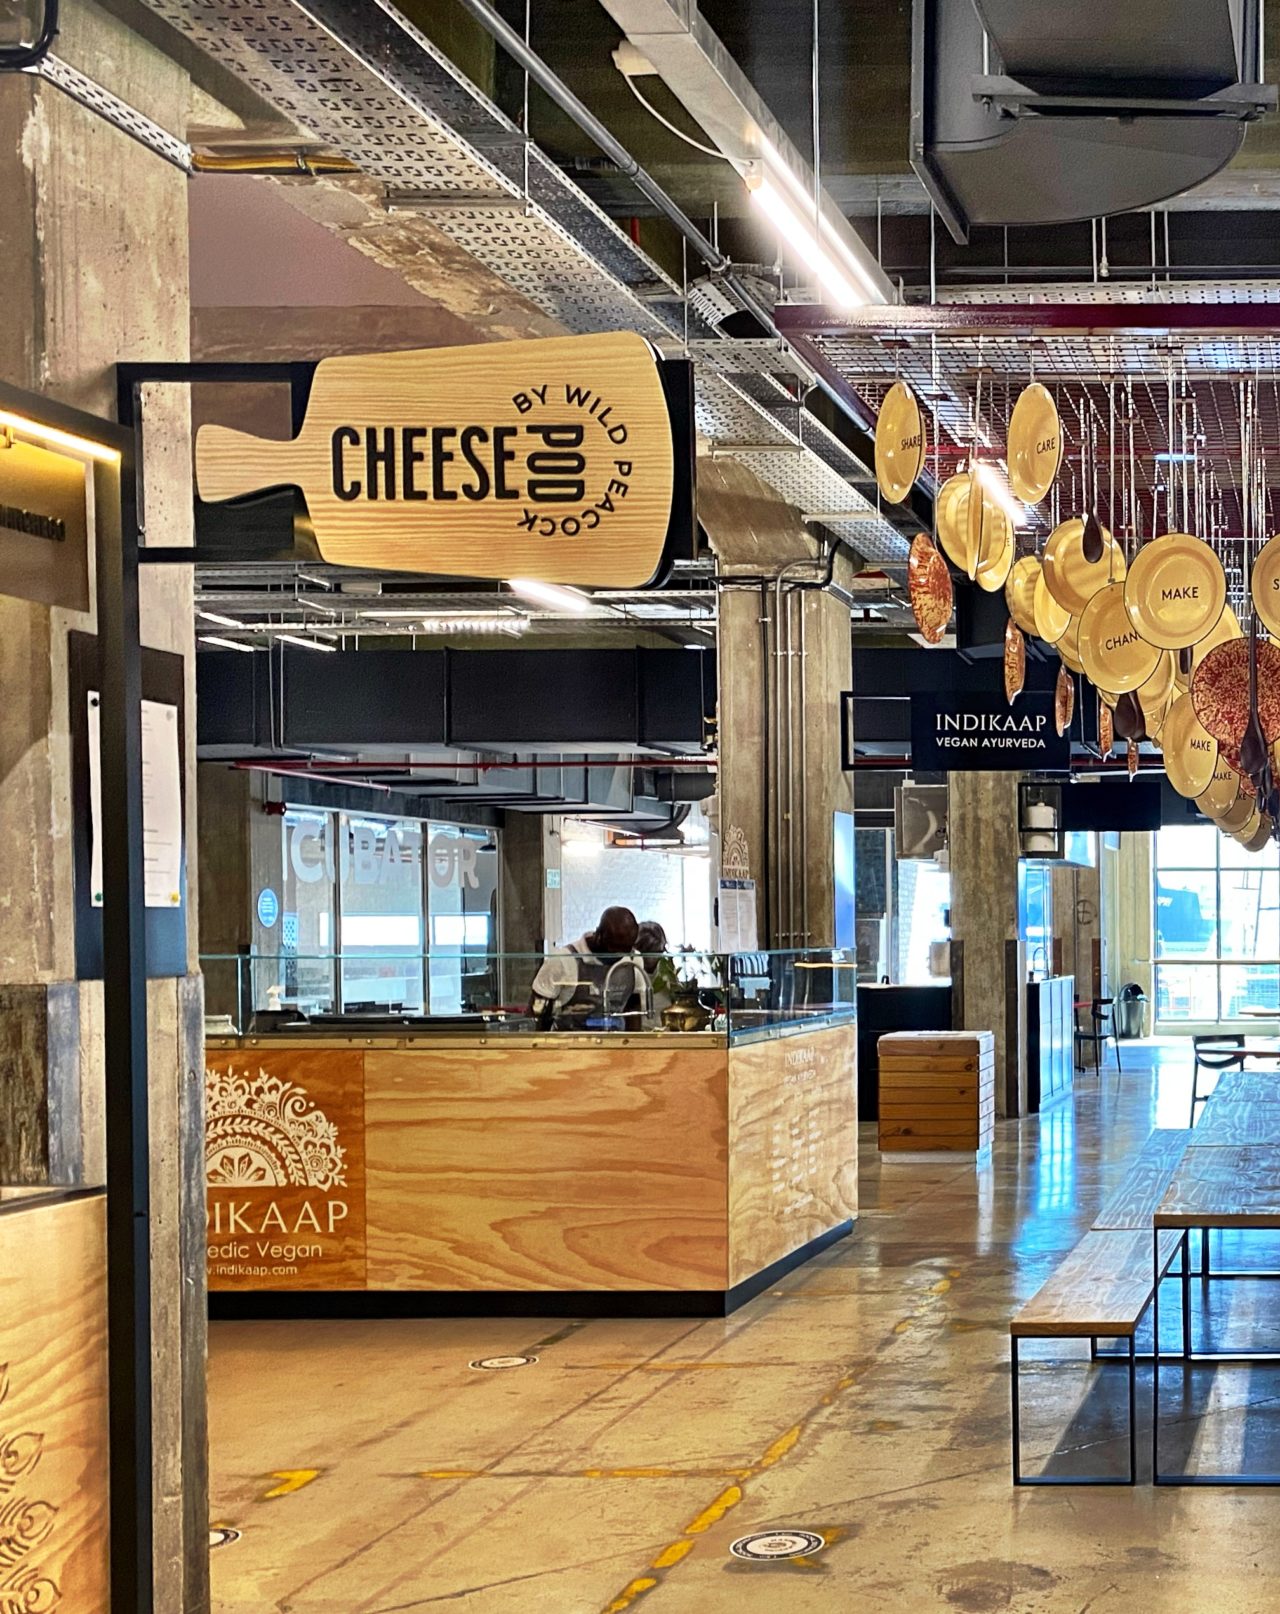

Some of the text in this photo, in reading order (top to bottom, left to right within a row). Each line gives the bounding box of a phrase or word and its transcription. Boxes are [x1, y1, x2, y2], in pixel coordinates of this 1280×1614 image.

[900, 435, 922, 451] SHARE
[1036, 437, 1056, 455] CARE
[331, 426, 520, 501] CHEESE
[512, 384, 633, 537] BY WILD PEACOCK
[525, 424, 586, 502] POD
[1161, 586, 1199, 601] MAKE
[1105, 629, 1139, 651] CHAN
[936, 713, 1047, 732] INDIKAAP
[936, 737, 1046, 748] VEGAN AYURVEDA
[1190, 739, 1211, 752] MAKE
[282, 818, 480, 889] CUBATOR
[206, 1200, 348, 1234] IKAAP
[206, 1241, 322, 1262] edic Vegan
